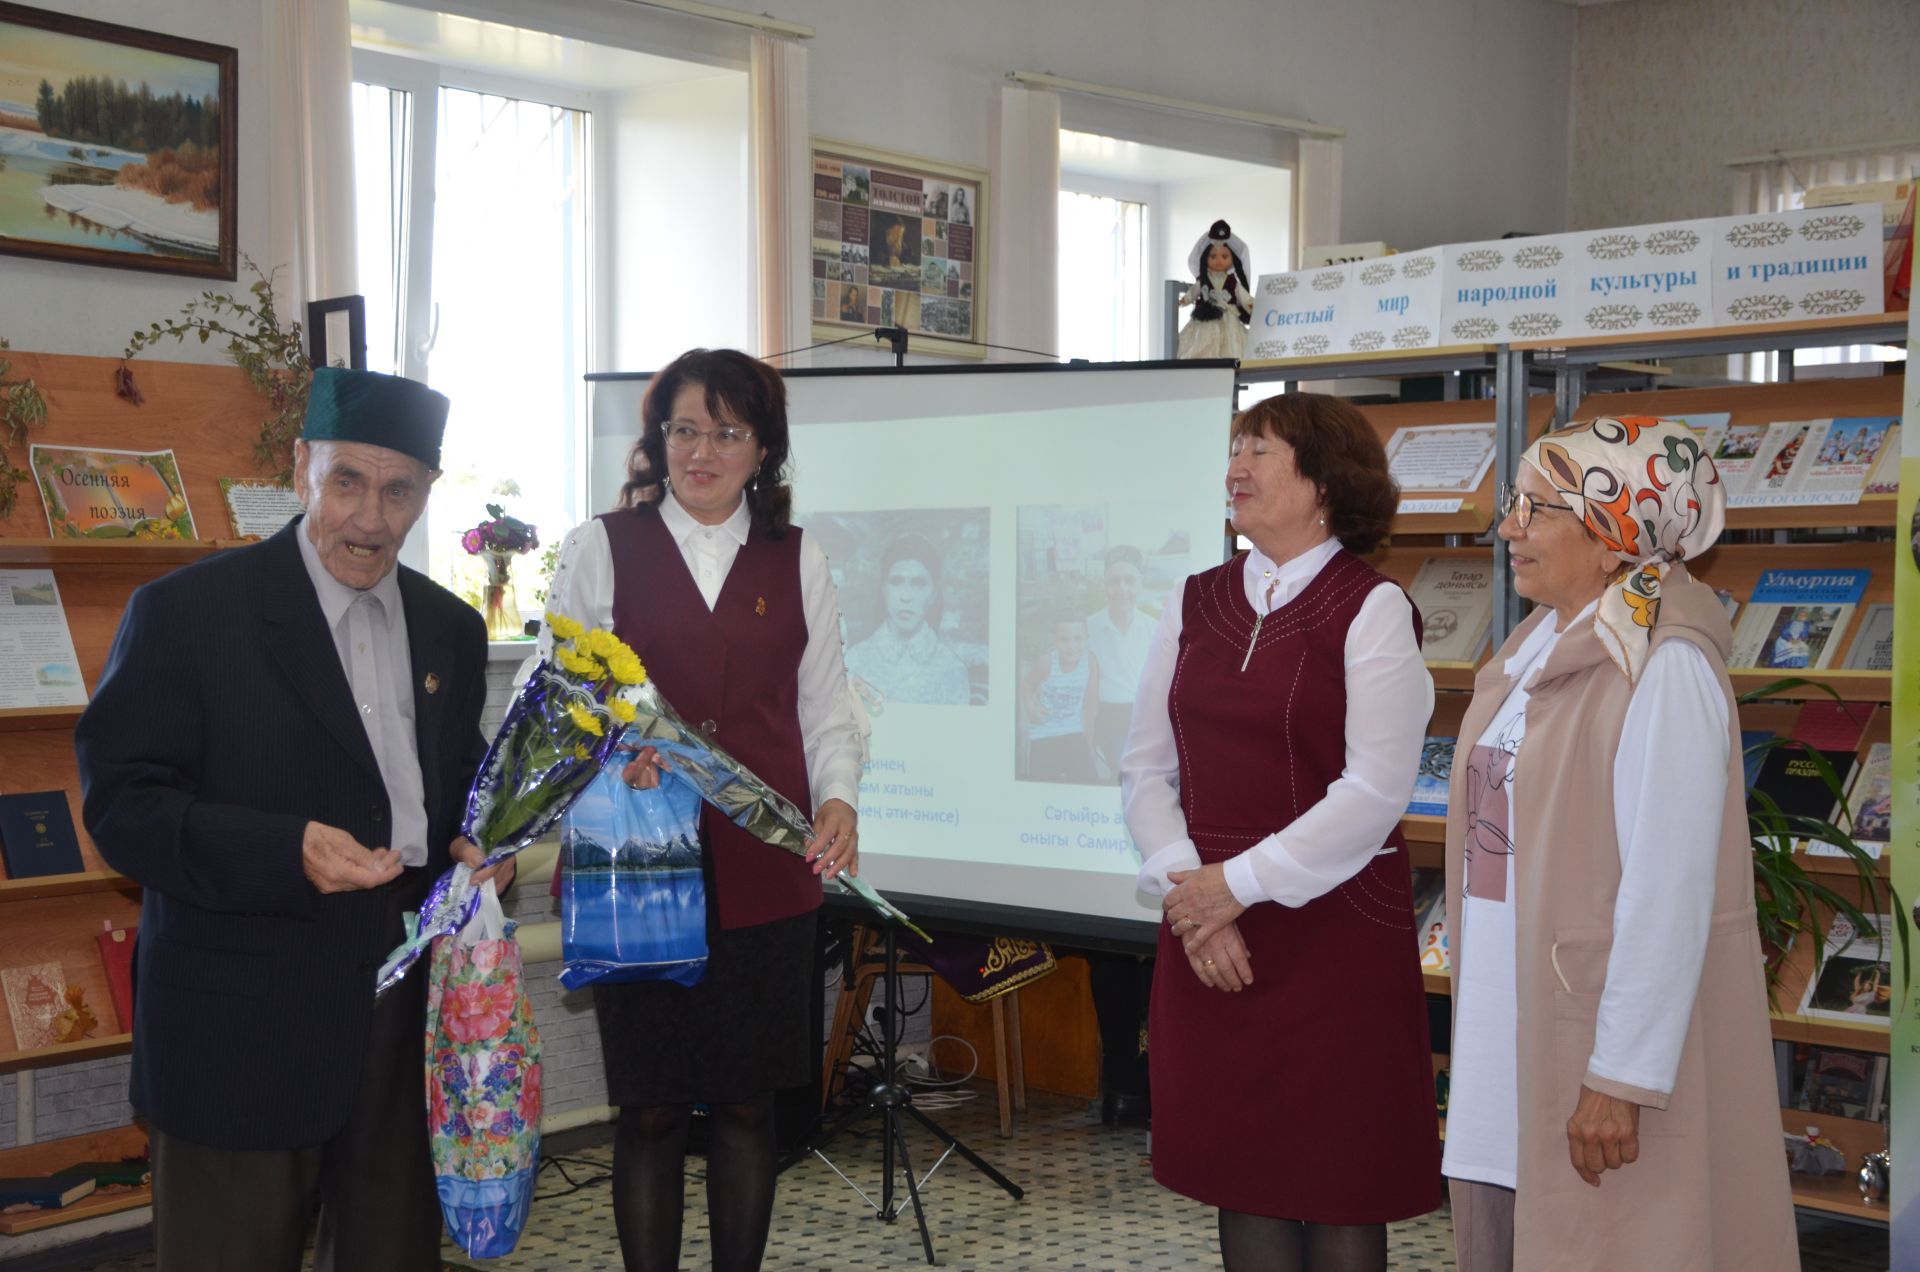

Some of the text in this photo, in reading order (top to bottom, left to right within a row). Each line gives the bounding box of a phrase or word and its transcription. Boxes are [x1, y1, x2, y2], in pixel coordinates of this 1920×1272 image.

[1265, 255, 1868, 328] Светлый мир народной культуры и традиции
[61, 467, 131, 488] Осенняя
[89, 506, 146, 520] поэзия
[1764, 571, 1856, 589] Удмуртия
[859, 759, 906, 774] динең
[883, 783, 935, 798] хатыны
[885, 807, 960, 828] әти-әнисе)
[1044, 804, 1110, 827] Сәгыйрь
[1020, 832, 1130, 854] оныгы Самир
